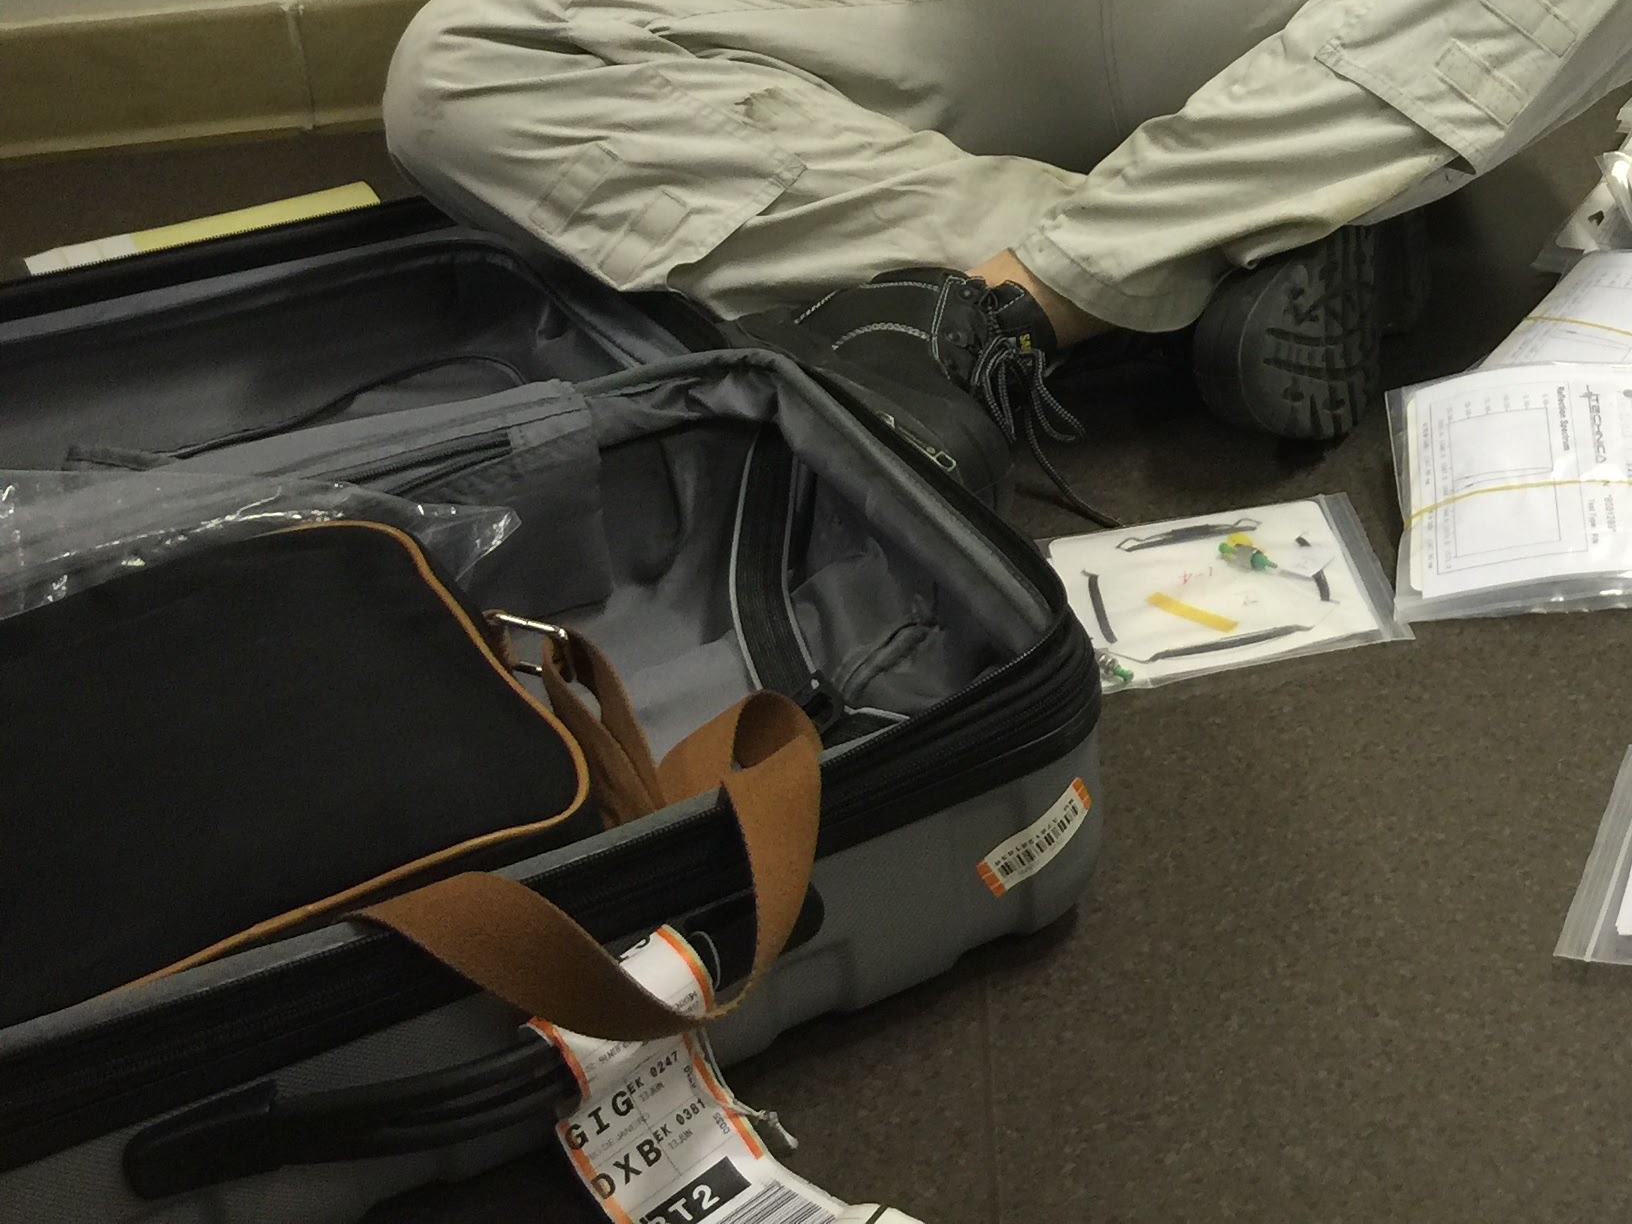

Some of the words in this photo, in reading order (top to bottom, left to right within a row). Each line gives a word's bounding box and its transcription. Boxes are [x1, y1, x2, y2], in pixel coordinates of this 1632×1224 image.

[564, 1090, 636, 1151] GIG
[627, 1074, 645, 1097] EK
[650, 1051, 679, 1080] 0247
[590, 1139, 662, 1199] DXB
[653, 1120, 672, 1144] EK
[675, 1099, 706, 1126] 0381
